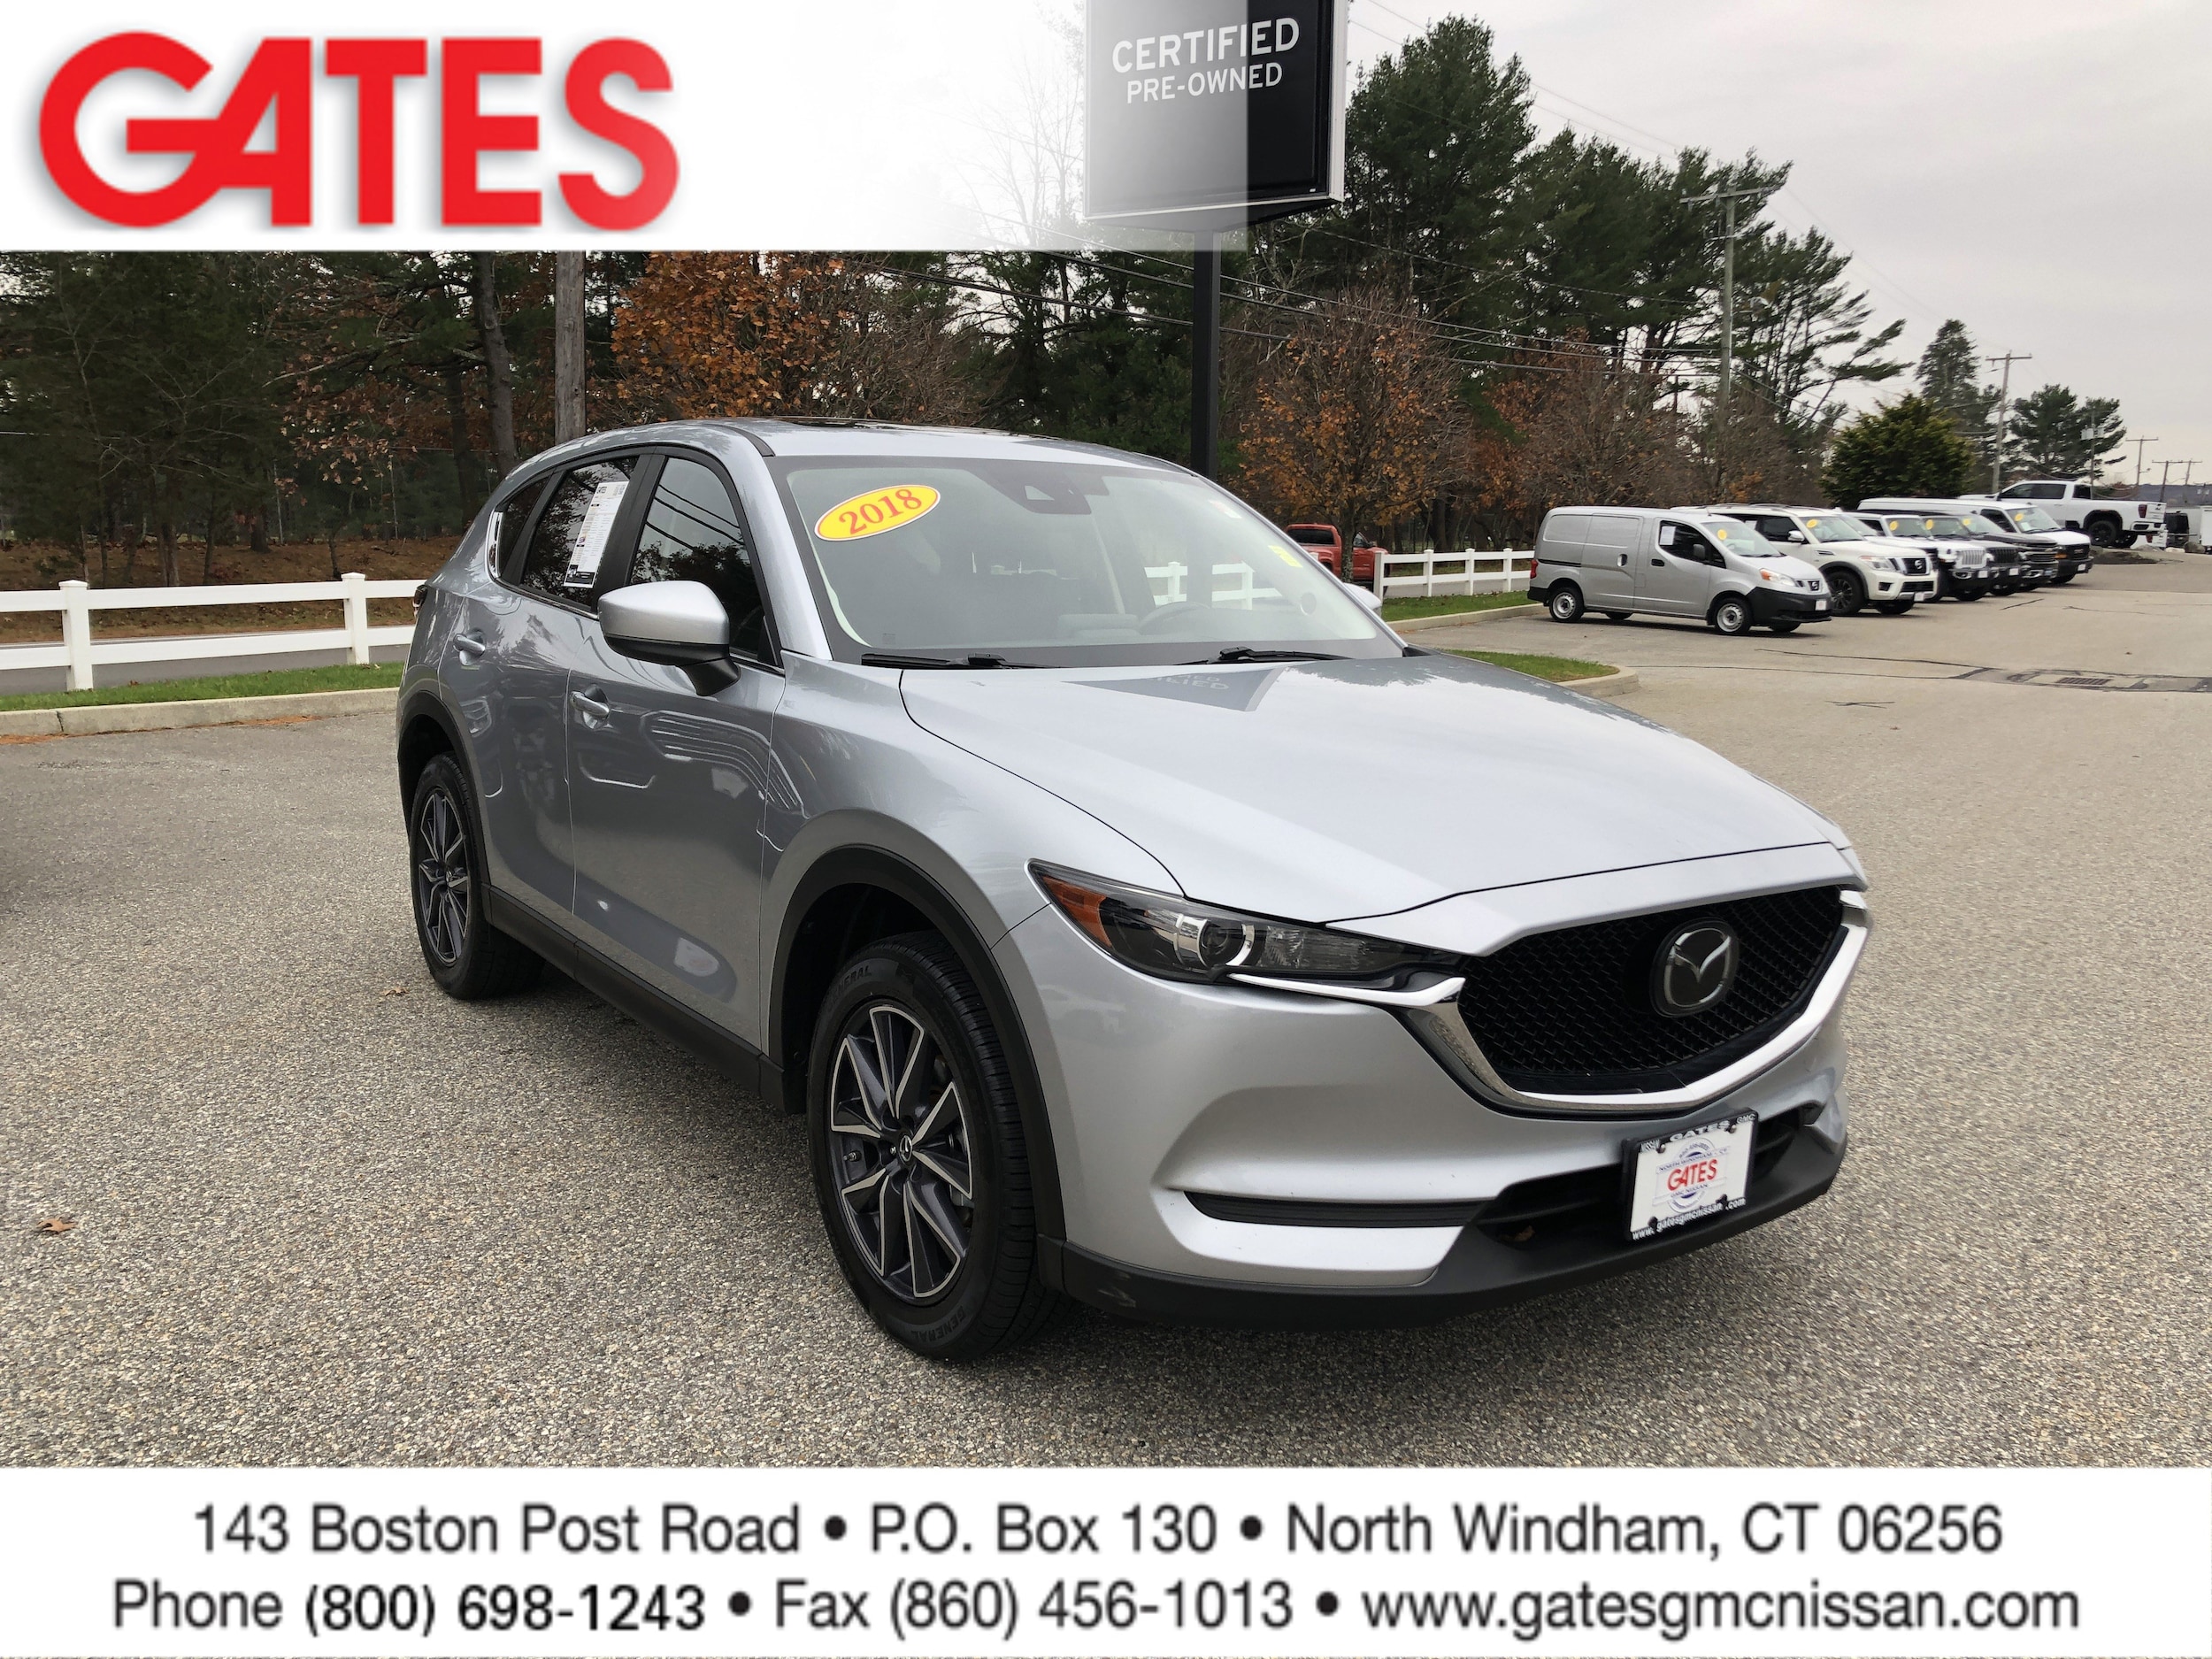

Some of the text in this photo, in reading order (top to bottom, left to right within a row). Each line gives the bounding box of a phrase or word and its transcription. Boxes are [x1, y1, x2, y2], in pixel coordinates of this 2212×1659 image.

[1112, 17, 1300, 73] CERTIFIED
[1126, 62, 1283, 104] PRE-OWNED
[838, 488, 923, 534] 2018
[1667, 1158, 1718, 1192] GATES
